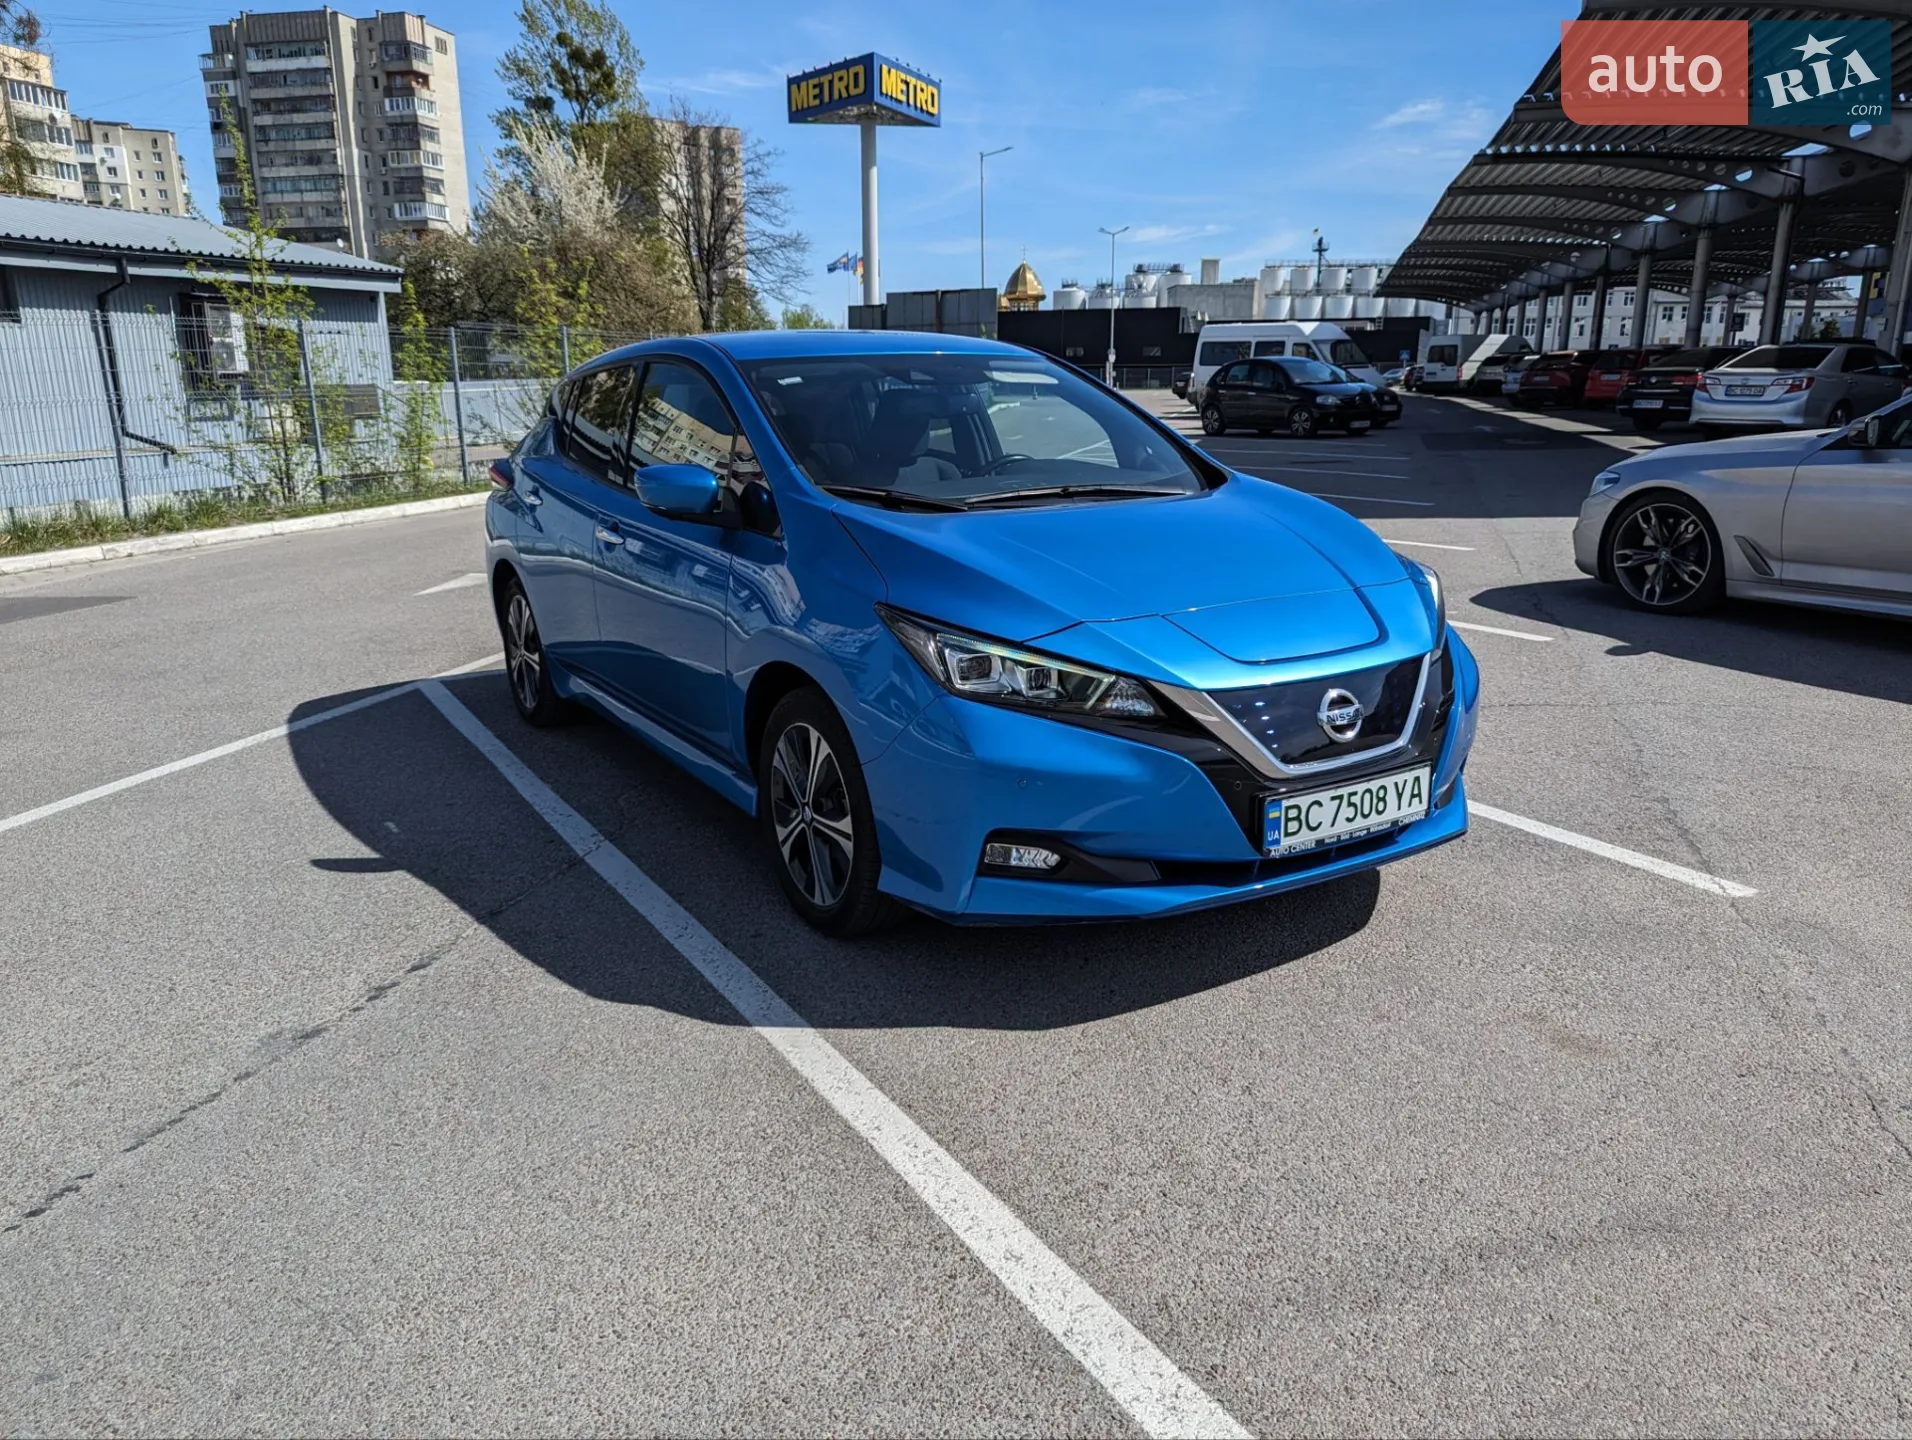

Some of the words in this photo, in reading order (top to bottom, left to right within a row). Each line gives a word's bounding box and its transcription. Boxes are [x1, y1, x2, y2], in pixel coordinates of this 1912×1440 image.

[790, 65, 865, 111] METRO
[881, 63, 939, 115] METRO
[1326, 707, 1364, 722] NISSAN
[1283, 800, 1324, 838] BC
[1329, 784, 1388, 828] 7508
[1393, 775, 1423, 811] YA
[1267, 830, 1280, 841] UA
[1270, 846, 1290, 858] AUTO
[1290, 840, 1316, 853] CENTER
